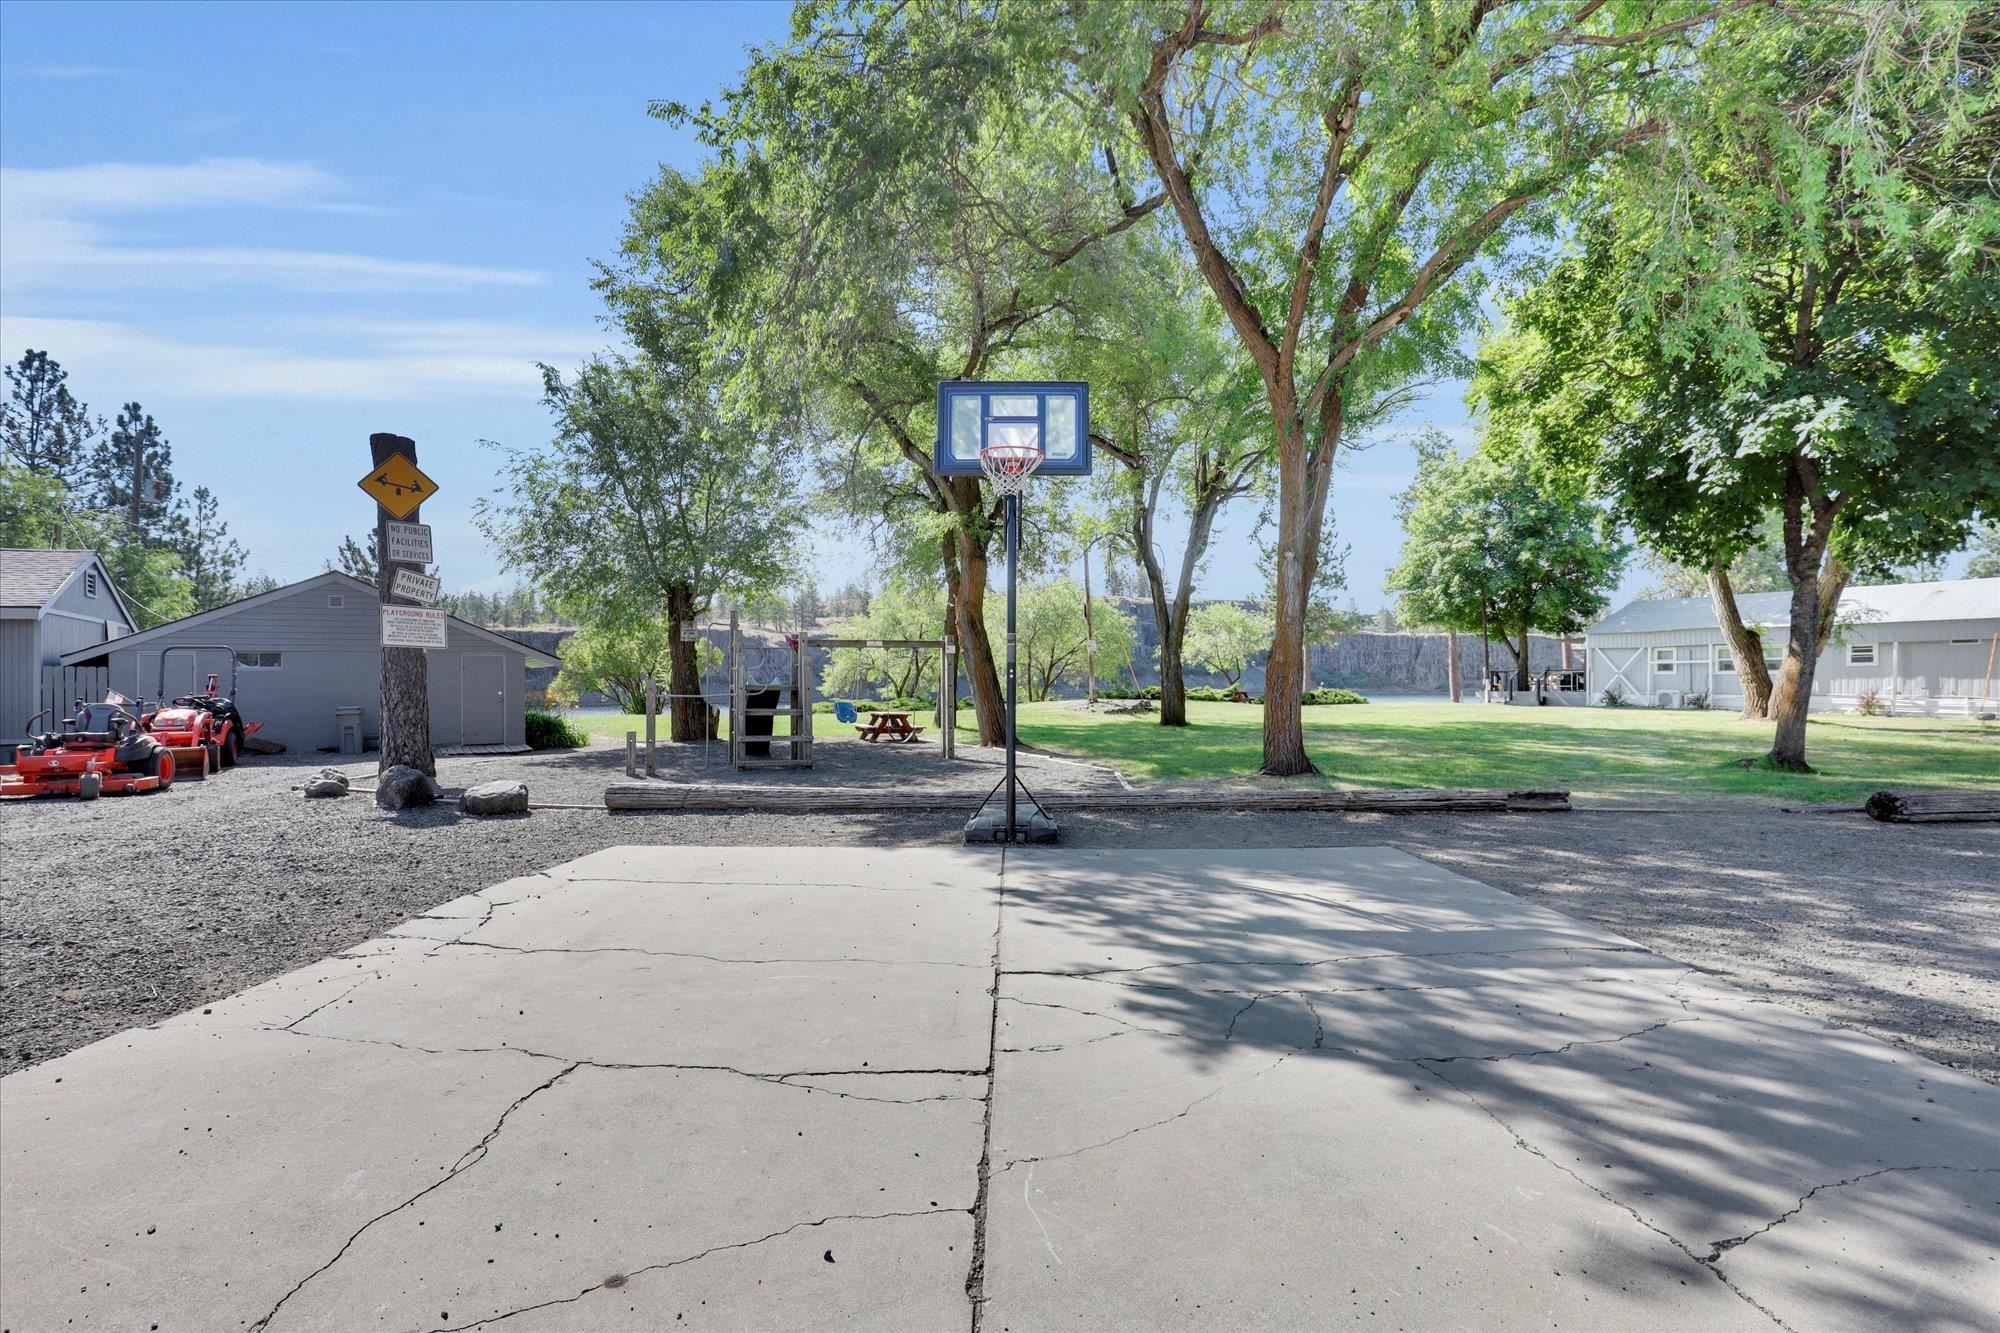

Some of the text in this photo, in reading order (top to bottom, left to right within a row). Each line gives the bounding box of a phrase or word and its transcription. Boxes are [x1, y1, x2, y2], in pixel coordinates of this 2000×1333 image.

[390, 525, 428, 536] NO PUBLIC
[391, 537, 429, 548] FACILITIES
[392, 549, 430, 560] OR SERVICES
[401, 573, 434, 589] PRIVATE
[395, 583, 434, 599] PROPERTY
[382, 609, 423, 618] PLAYGROUND
[426, 612, 444, 620] RULES
